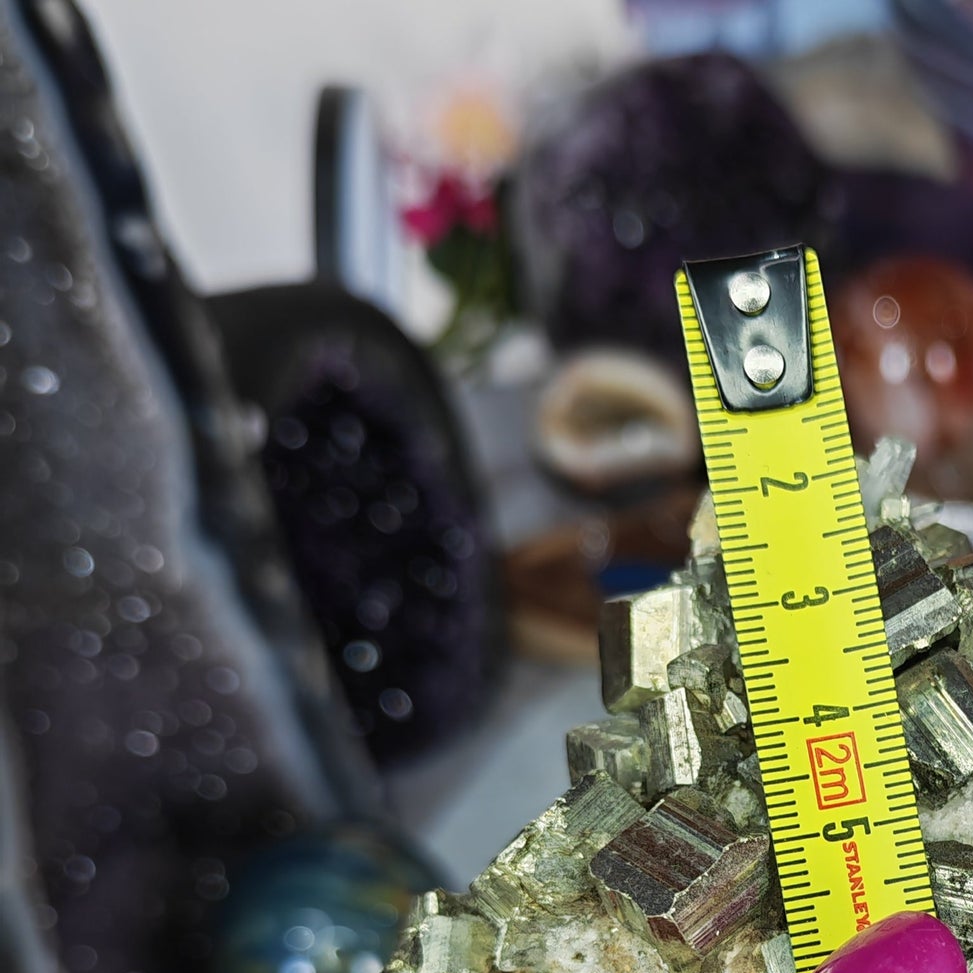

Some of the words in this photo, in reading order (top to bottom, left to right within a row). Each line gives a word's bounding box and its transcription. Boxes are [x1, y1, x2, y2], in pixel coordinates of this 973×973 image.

[760, 471, 809, 497] 2
[780, 586, 830, 611] 3
[803, 704, 850, 727] 4
[814, 743, 852, 802] 2m
[822, 816, 871, 842] 5
[842, 841, 871, 926] STANLEY
